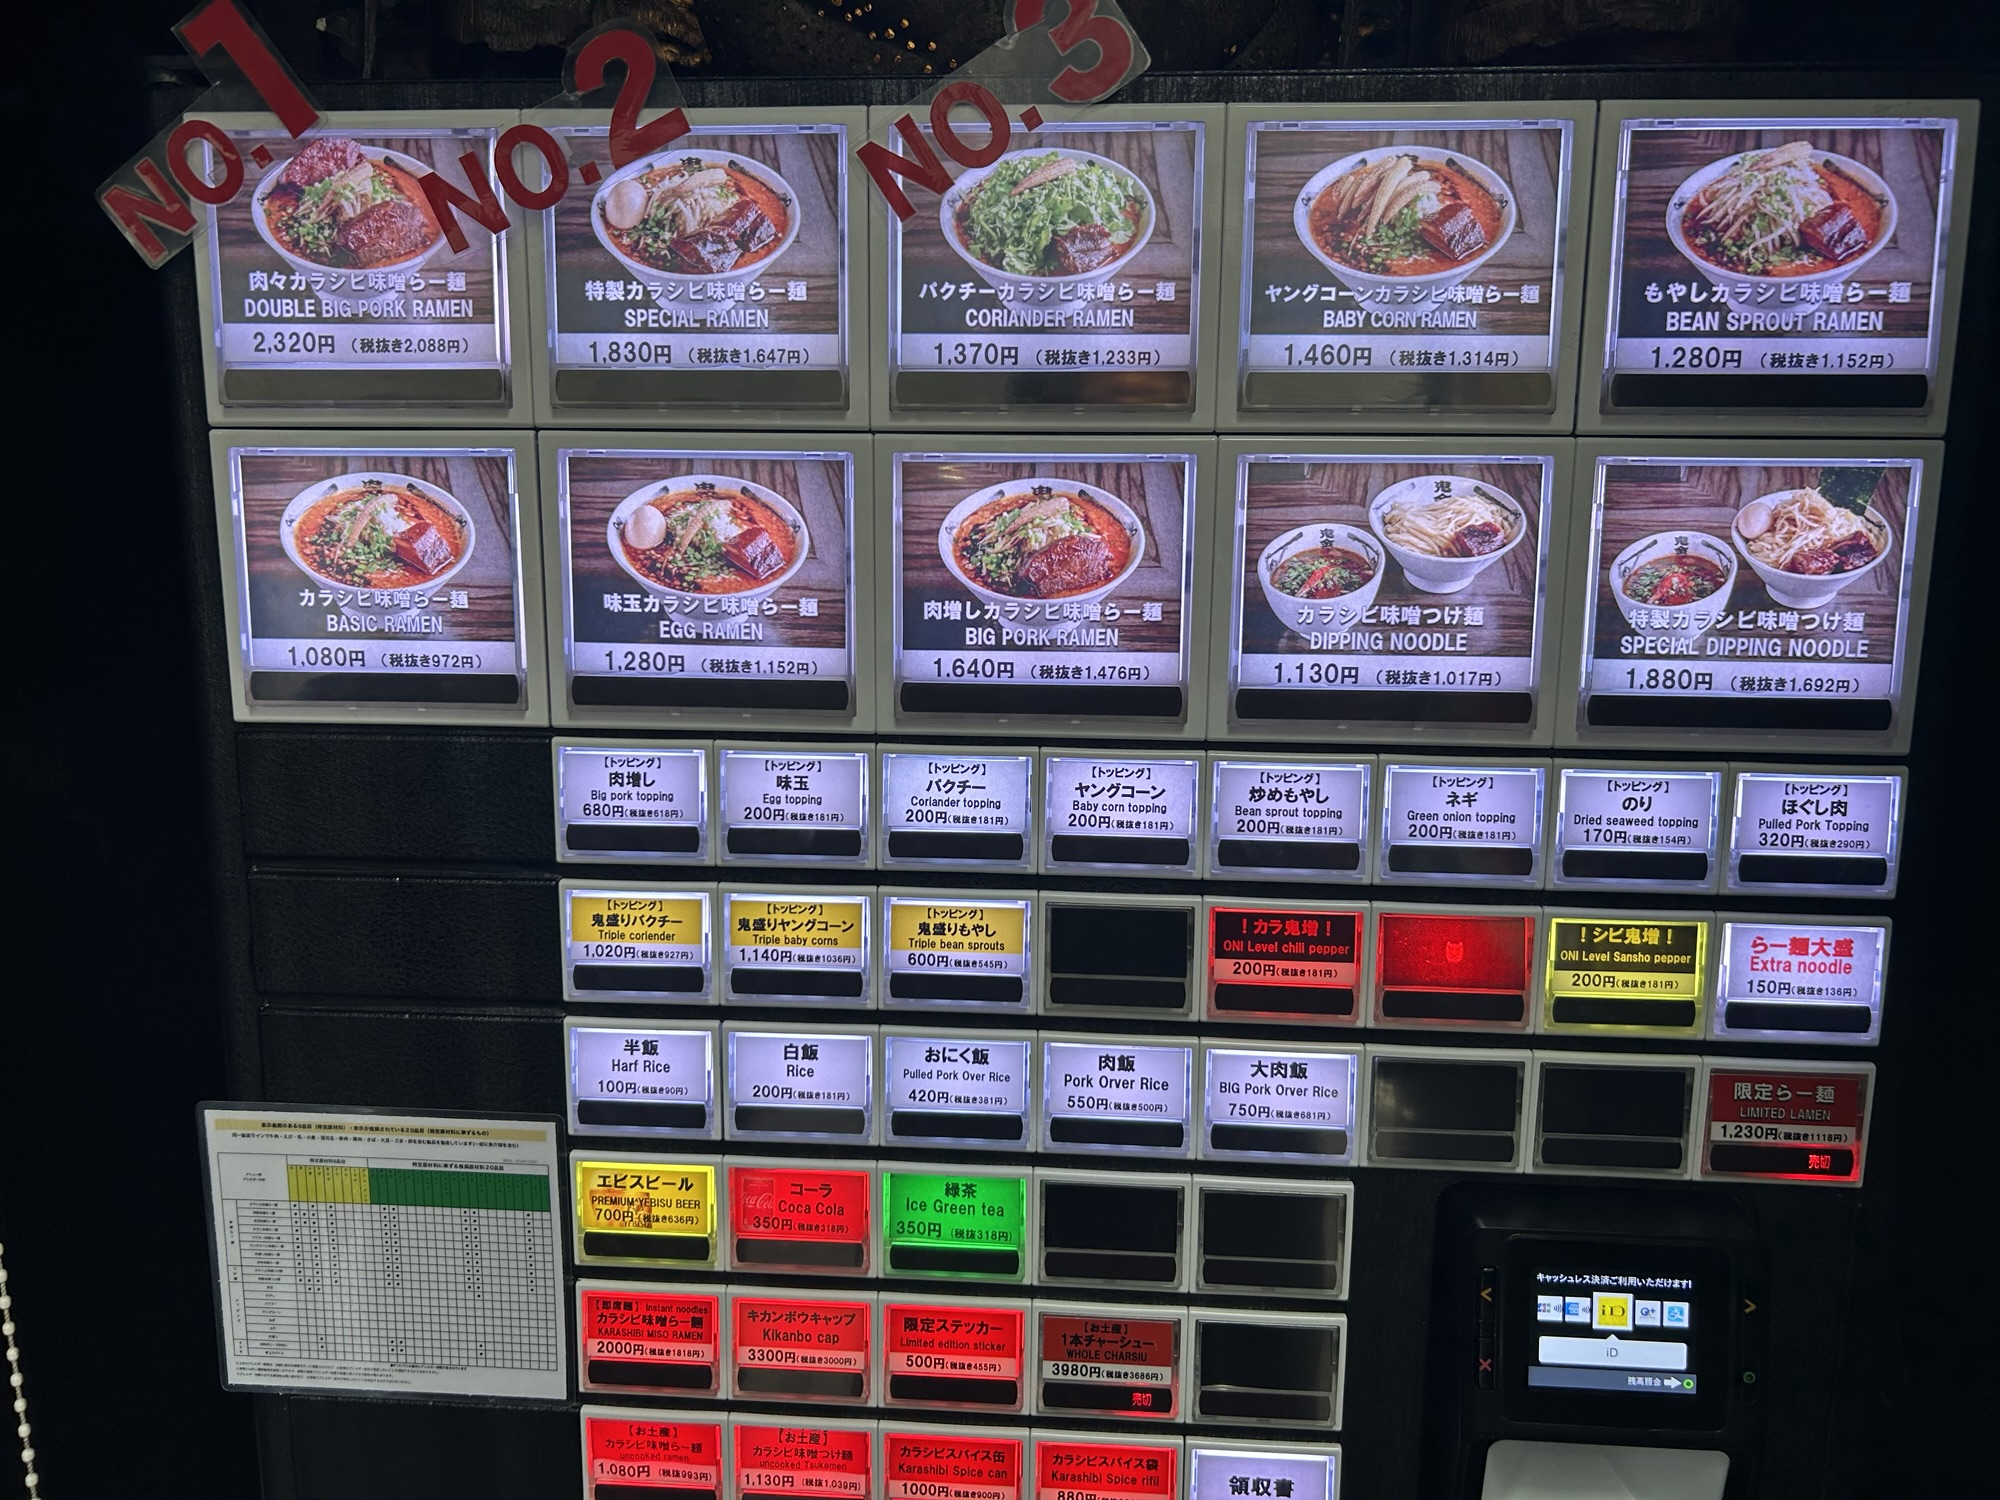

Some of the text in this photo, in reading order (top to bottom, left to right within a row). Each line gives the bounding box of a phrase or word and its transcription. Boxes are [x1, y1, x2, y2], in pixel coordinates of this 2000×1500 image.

[856, 0, 1132, 223] NO.3
[102, 0, 320, 262] NO.1
[418, 29, 691, 254] NO.2
[249, 271, 466, 292] 肉々カラシビ味噌らー麺
[585, 280, 807, 301] 特製カラシビ味噌らー麺
[919, 282, 1176, 301] パクチーカラシビ味噌らー麺
[1265, 284, 1541, 304] ヤングコーンカラシビ味噌らー麺
[1645, 282, 1912, 304] もやしカラシビ味噌らー麺
[245, 299, 473, 318] DOUBLE BIG PORK RAMEN
[624, 309, 769, 328] SPECIAL RAMEN
[965, 308, 1134, 328] CORIANDER RAMEN
[1323, 311, 1477, 329] BABY CORN RAMEN
[1666, 312, 1885, 331] BEAN SPROUT RAMEN
[253, 332, 335, 354] 2,320円
[589, 342, 672, 364] 1,830円
[934, 342, 1019, 365] 1,370円
[1284, 344, 1372, 366] 1,460円
[1651, 347, 1742, 369] 1,280円
[299, 589, 469, 609] カラシビ味噌らー麺
[603, 593, 819, 617] 味玉カラシビ味噌らー麺
[923, 601, 1162, 622] 肉増しカラシビ味噌らー麺
[1298, 606, 1484, 626] カラシビ味噌つけ麺
[1629, 609, 1865, 632] 特製カラシビ味噌つけ麺
[327, 615, 443, 633] BASIC RAMEN
[659, 621, 763, 640] EGG RAMEN
[965, 627, 1119, 647] BIG PORK RAMEN
[1310, 632, 1467, 651] DIPPING NOODLE
[1621, 636, 1869, 658] SPECIAL DIPPING NOODLE
[288, 647, 366, 667] 1,080円
[605, 651, 685, 672] 1,280円
[934, 658, 1014, 678] 1,640円
[1274, 662, 1359, 685] 1,130円
[1626, 669, 1713, 690] 1,880円
[604, 756, 661, 768] 【トッピング】
[608, 772, 656, 787] 肉増し
[776, 776, 809, 791] 味玉
[926, 778, 986, 793] パクチー
[1432, 776, 1494, 788] 【トッピング】
[591, 790, 674, 802] Big pork topping
[1075, 782, 1166, 799] ヤングコーン
[1249, 786, 1329, 804] 炒めもやし
[763, 794, 822, 806] Egg topping
[910, 796, 1001, 810] Coriander topping
[1446, 792, 1478, 808] ネギ
[1622, 797, 1652, 812] のり
[1781, 800, 1848, 817] ほぐし肉
[1574, 815, 1698, 828] Dried seaweed topping
[1758, 819, 1869, 833] Pulled Pork Topping
[592, 914, 683, 928] 鬼盛りパクチー
[928, 908, 984, 920] 【トッピング】
[738, 918, 854, 932] 鬼盛りヤングコーン
[918, 922, 996, 937] 鬼盛りもやし
[908, 938, 1005, 950] Triple bean sprouts
[1223, 940, 1350, 956] ONI Level chili pepper
[1751, 937, 1854, 957] らー麺大盛
[1750, 956, 1853, 975] Extra noodle
[624, 1040, 660, 1056] 半飯
[783, 1043, 819, 1061] 白飯
[925, 1047, 989, 1065] おにく飯
[612, 1060, 670, 1073] Harf Rice
[786, 1065, 814, 1078] Rice
[1098, 1054, 1135, 1072] 肉飯
[1250, 1060, 1308, 1079] 大肉飯
[1064, 1074, 1169, 1090] Pork Orver Rice
[1733, 1082, 1835, 1103] 限定らー麺
[1740, 1107, 1831, 1120] LIMITED LAMEN
[1808, 1154, 1831, 1169] 売切
[790, 1183, 833, 1198] コーラ
[944, 1182, 977, 1198] 緑茶
[592, 1196, 700, 1209] PREMIUM YEBISU BEER
[778, 1200, 811, 1214] Coca
[816, 1202, 844, 1216] Cola
[906, 1197, 1004, 1217] Ice Green tea
[897, 1221, 942, 1238] 350円
[747, 1310, 856, 1326] キカンボウキャップ
[904, 1317, 1003, 1335] 限定ステッカー
[763, 1328, 839, 1345] Kikanbo cap
[1062, 1334, 1154, 1349] 1本チャーシュー
[1067, 1349, 1147, 1362] WHOLE CHARSIU
[1606, 1348, 1618, 1358] iD
[598, 1463, 650, 1478] 1,080円
[898, 1463, 1007, 1479] Karashibi Spice can
[1229, 1476, 1294, 1498] 領収書
